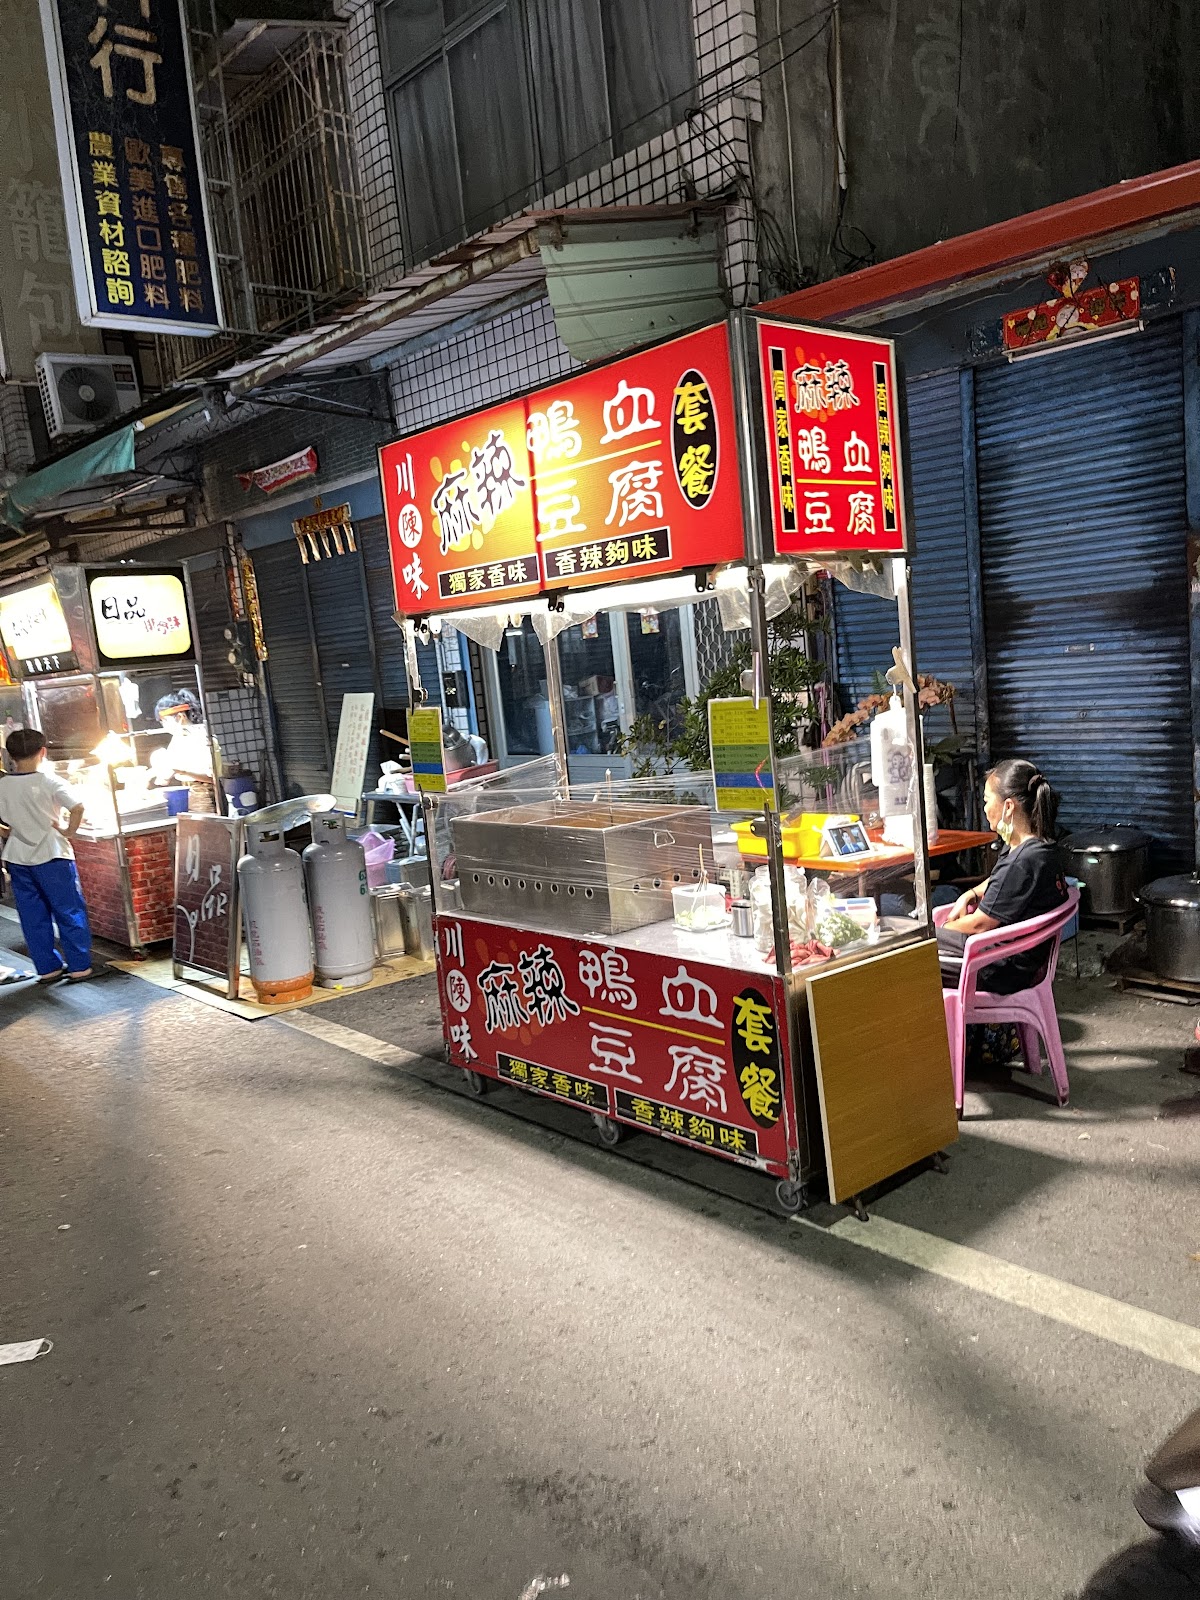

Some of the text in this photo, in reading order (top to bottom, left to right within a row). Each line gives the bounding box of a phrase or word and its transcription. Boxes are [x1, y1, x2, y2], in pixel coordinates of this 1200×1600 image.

[87, 0, 163, 105] 行
[88, 131, 134, 307] 農業資材諮詢
[792, 358, 861, 414] 麻辣
[673, 381, 715, 499] 套餐
[797, 425, 873, 474] 鴨血
[431, 428, 526, 556] 麻辣
[534, 460, 664, 542] 豆腐
[803, 490, 876, 536] 豆腐
[448, 560, 528, 594] 獨家香味
[554, 534, 659, 577] 香辣夠味
[477, 943, 581, 1036] 麻辣
[509, 1057, 595, 1105] 獨家香味
[588, 1021, 728, 1114] 豆腐
[733, 996, 779, 1123] 套餐
